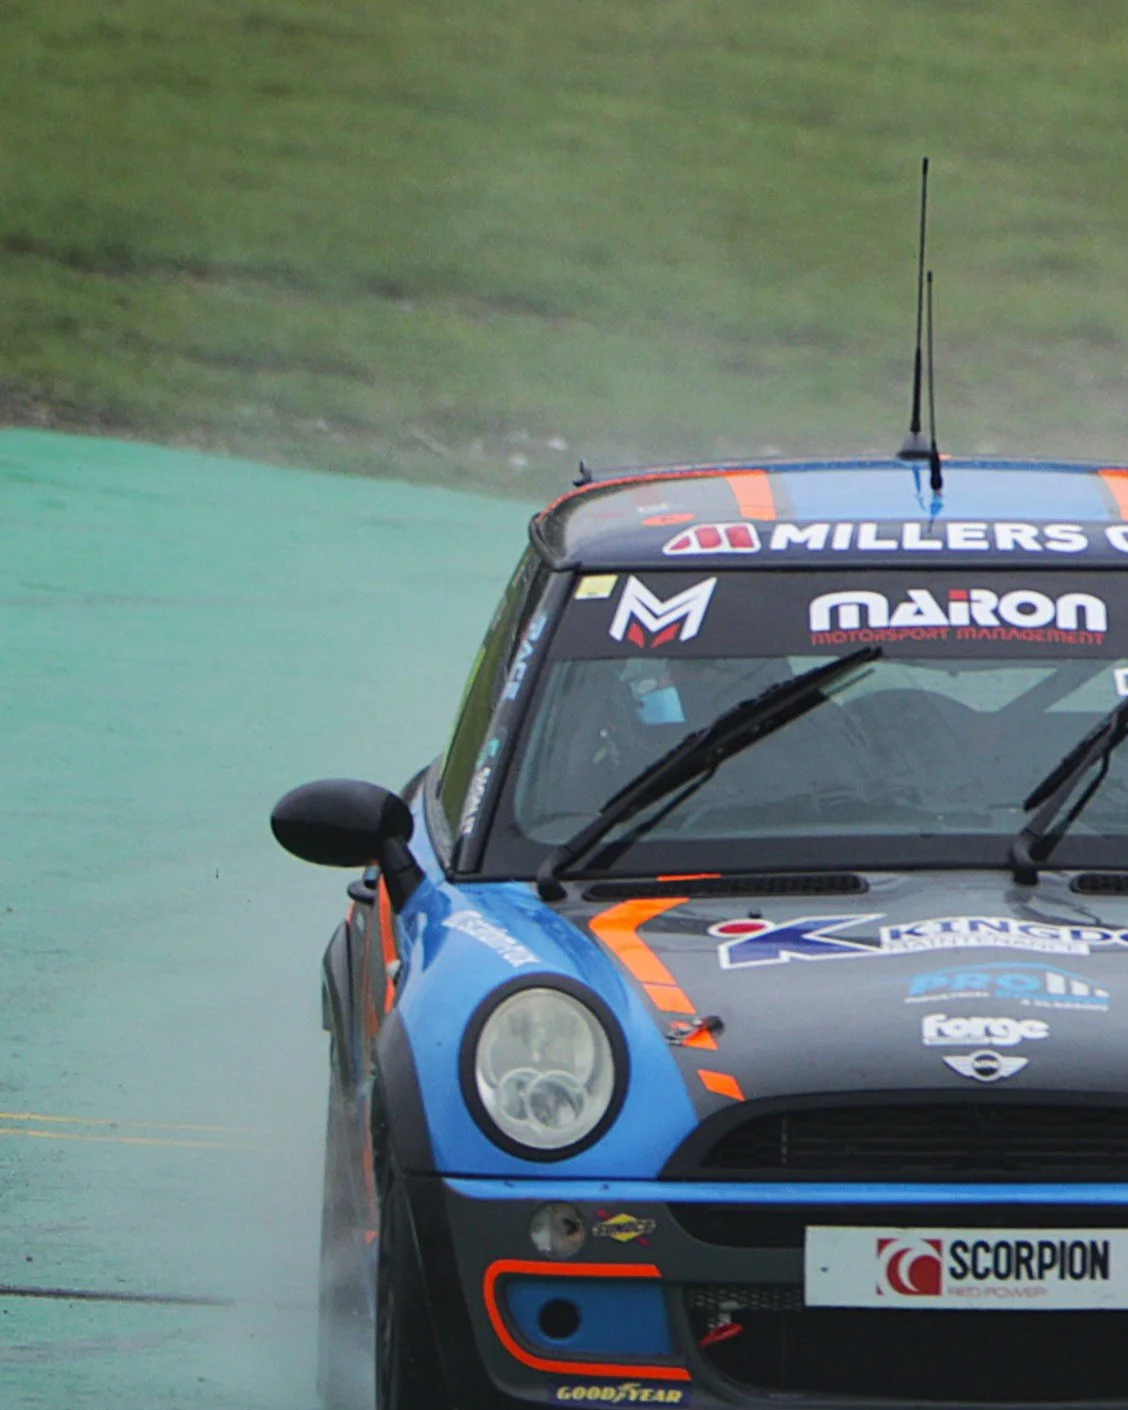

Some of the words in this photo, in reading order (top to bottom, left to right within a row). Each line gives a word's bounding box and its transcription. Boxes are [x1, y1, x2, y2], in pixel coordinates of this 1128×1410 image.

[769, 522, 1088, 552] MILLERS
[811, 628, 949, 646] MOTORSPORT
[956, 627, 1105, 645] MANAGEMENT
[949, 1240, 1109, 1281] SCORPION
[556, 1382, 683, 1404] GOODYEAR
